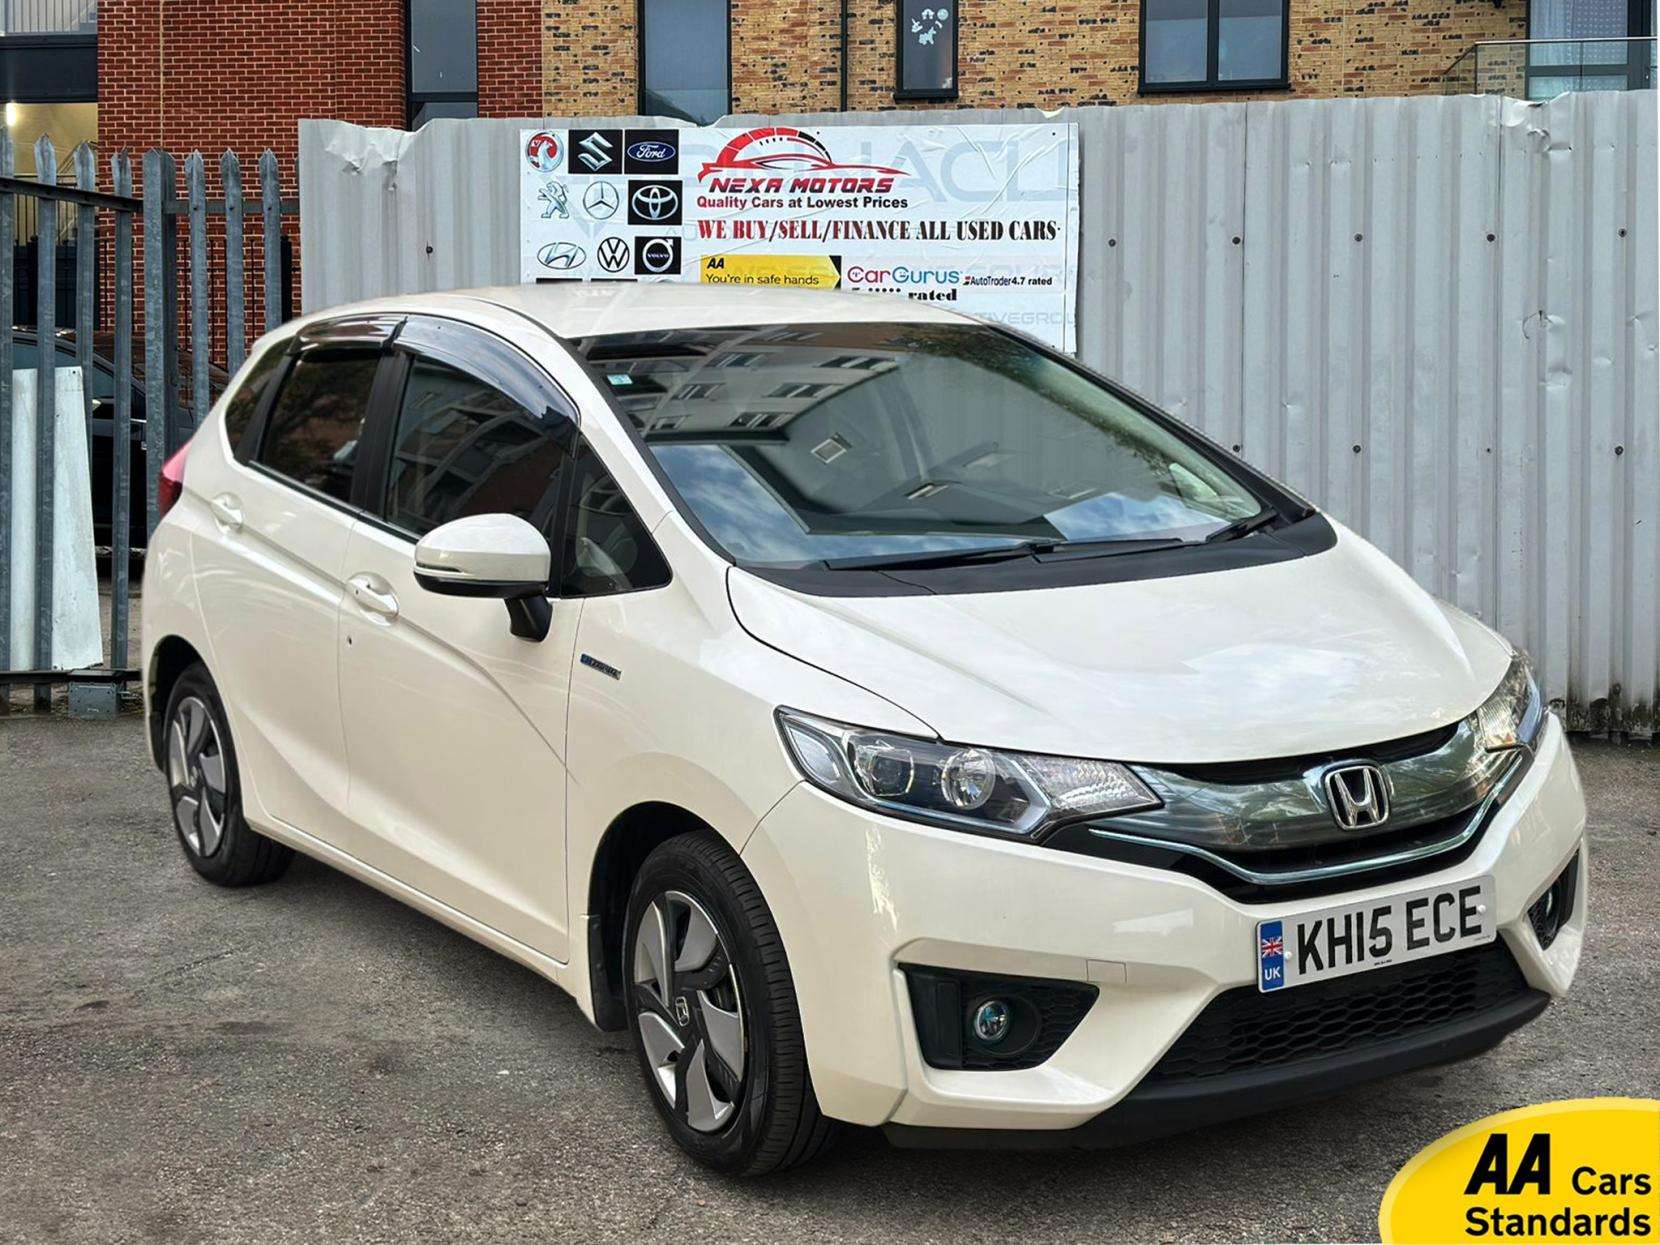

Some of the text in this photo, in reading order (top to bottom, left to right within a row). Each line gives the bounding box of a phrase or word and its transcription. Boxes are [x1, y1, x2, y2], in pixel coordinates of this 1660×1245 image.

[636, 143, 666, 158] Ford
[709, 178, 894, 193] NEXA MOTORS
[697, 196, 908, 210] Quality Cars at Lowest Prices
[697, 220, 727, 239] WE
[732, 219, 911, 242] BUY/SELL/FINANCE
[916, 221, 951, 240] ALL
[957, 221, 1004, 240] USED
[1008, 220, 1057, 240] CARS
[706, 257, 725, 269] AA
[706, 274, 819, 286] You're in safe hands
[847, 266, 960, 284] CarGurus
[1027, 276, 1053, 286] rated
[908, 288, 957, 301] rated
[1297, 885, 1482, 975] KH15 ECE
[1264, 966, 1281, 981] UK
